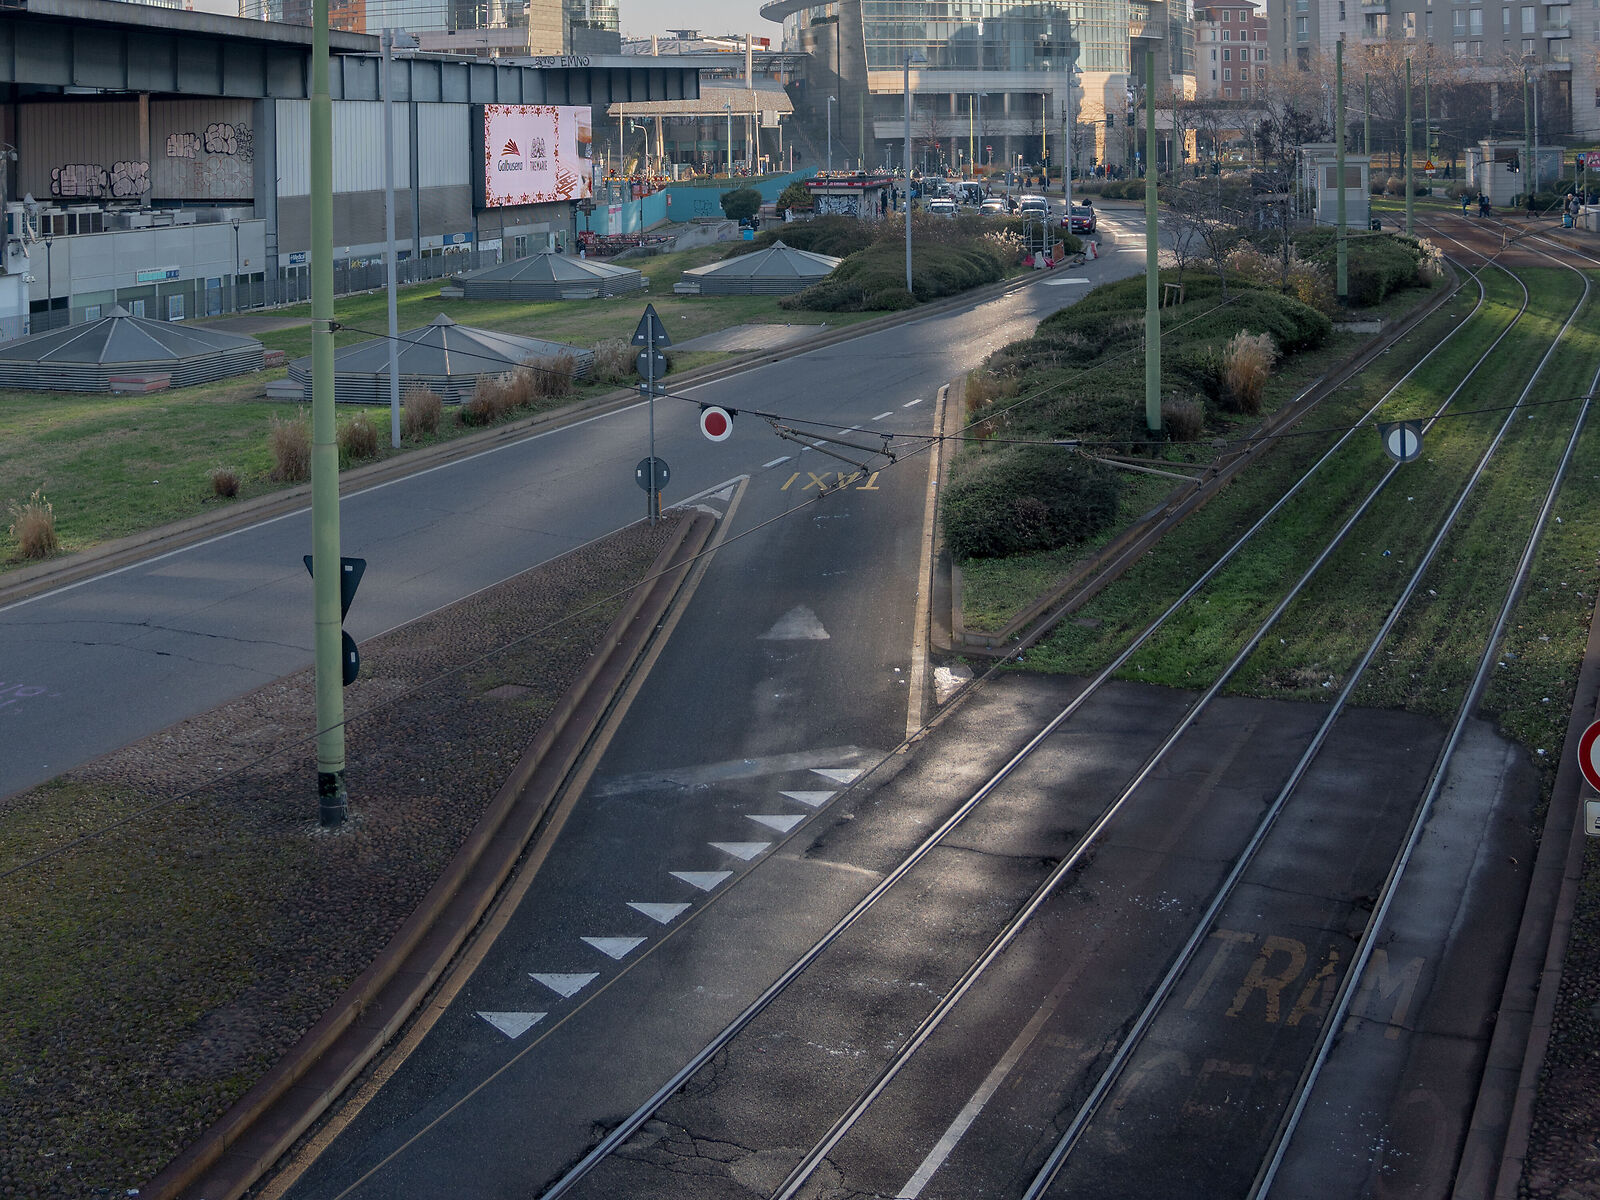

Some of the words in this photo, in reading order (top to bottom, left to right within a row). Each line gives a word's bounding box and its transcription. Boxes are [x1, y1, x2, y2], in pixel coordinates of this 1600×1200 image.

[497, 159, 523, 172] Galbusera
[780, 471, 880, 491] TAXI
[1183, 928, 1425, 1042] TRAM
